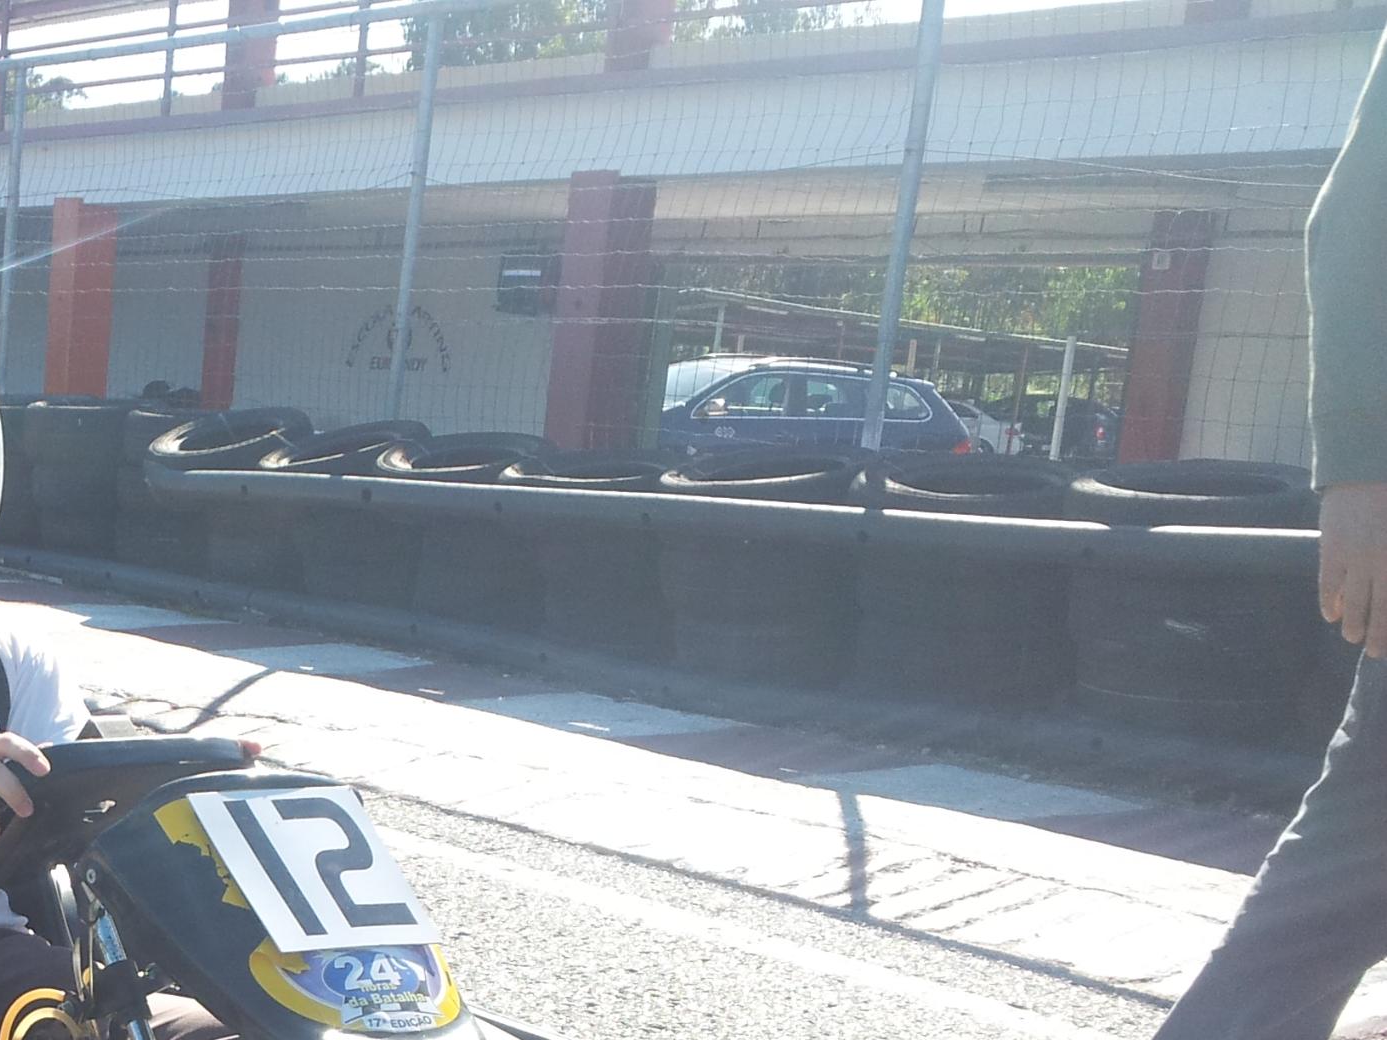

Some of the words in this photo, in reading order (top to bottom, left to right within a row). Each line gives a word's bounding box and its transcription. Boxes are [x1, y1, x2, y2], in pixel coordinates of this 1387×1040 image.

[223, 796, 419, 937] 12
[334, 954, 402, 991] 24
[348, 996, 369, 1009] da
[370, 991, 427, 1006] Batalha
[390, 1014, 432, 1029] EDIÇÃO
